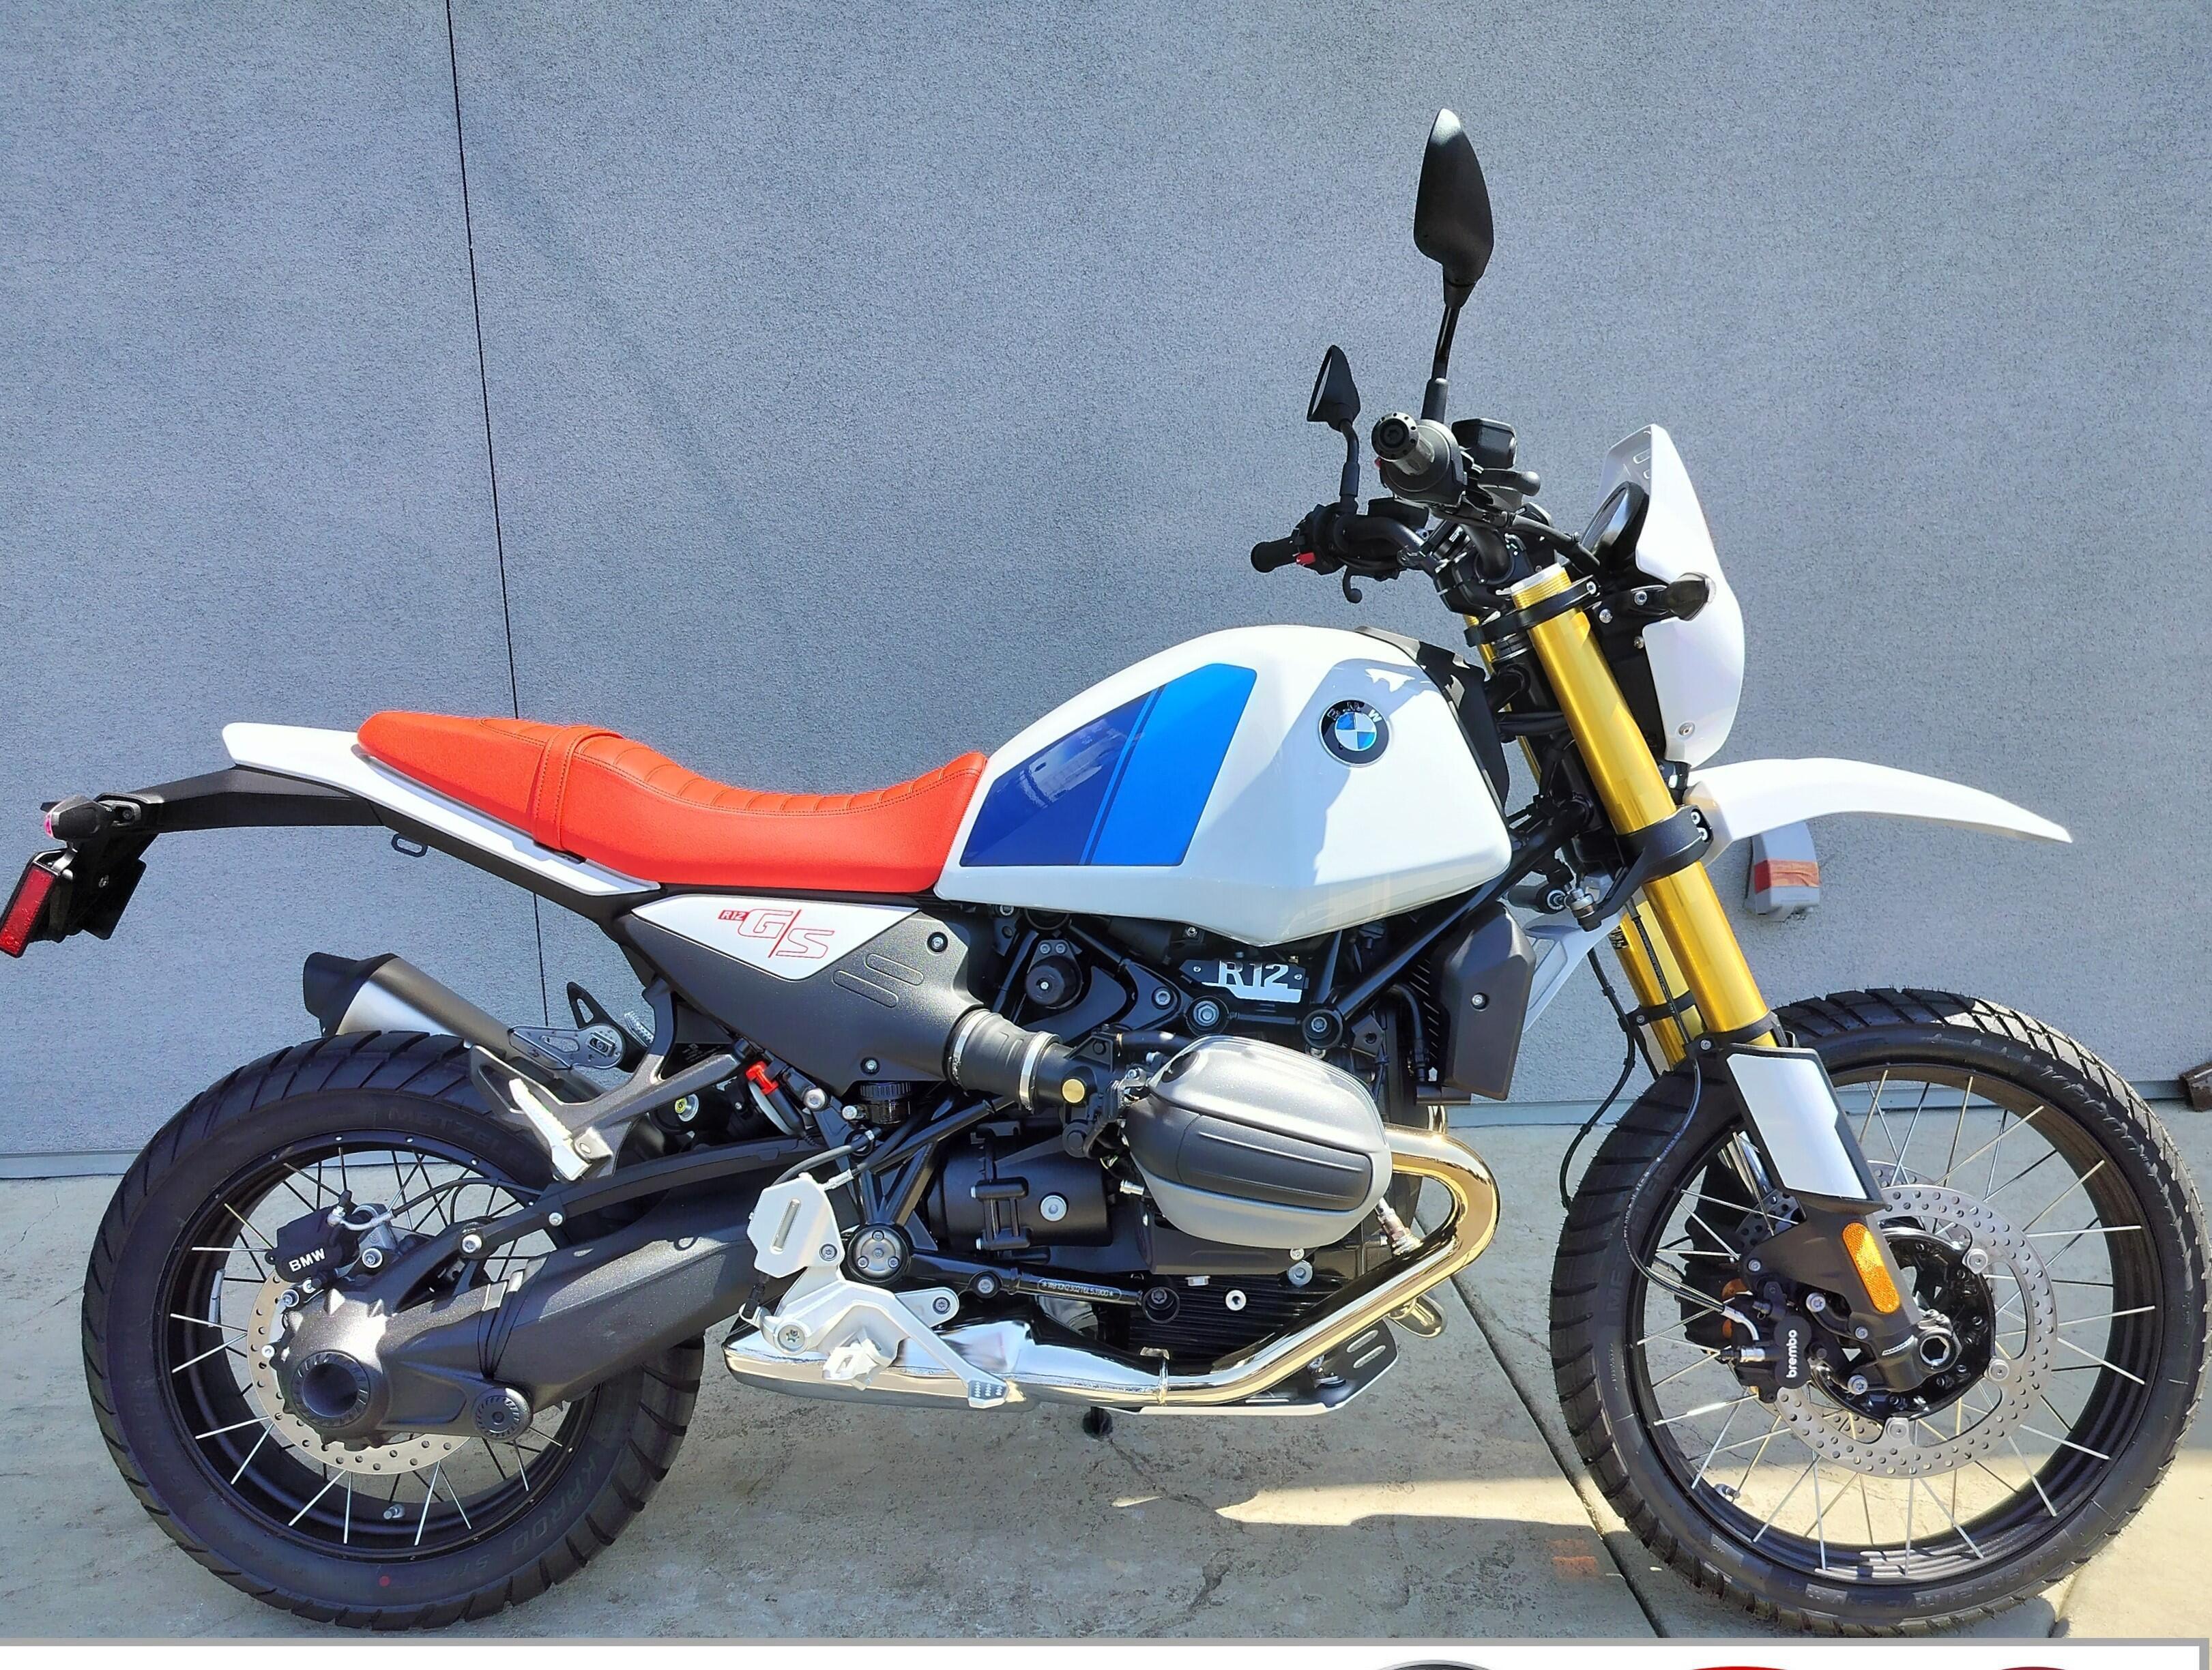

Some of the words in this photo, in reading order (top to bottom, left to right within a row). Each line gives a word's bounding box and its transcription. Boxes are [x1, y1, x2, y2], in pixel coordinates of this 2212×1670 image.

[1326, 701, 1382, 723] BMW
[720, 911, 748, 921] R12
[738, 908, 835, 959] G/S
[1218, 960, 1290, 989] R12
[288, 1248, 325, 1272] BMW
[1786, 1330, 1799, 1379] brembo
